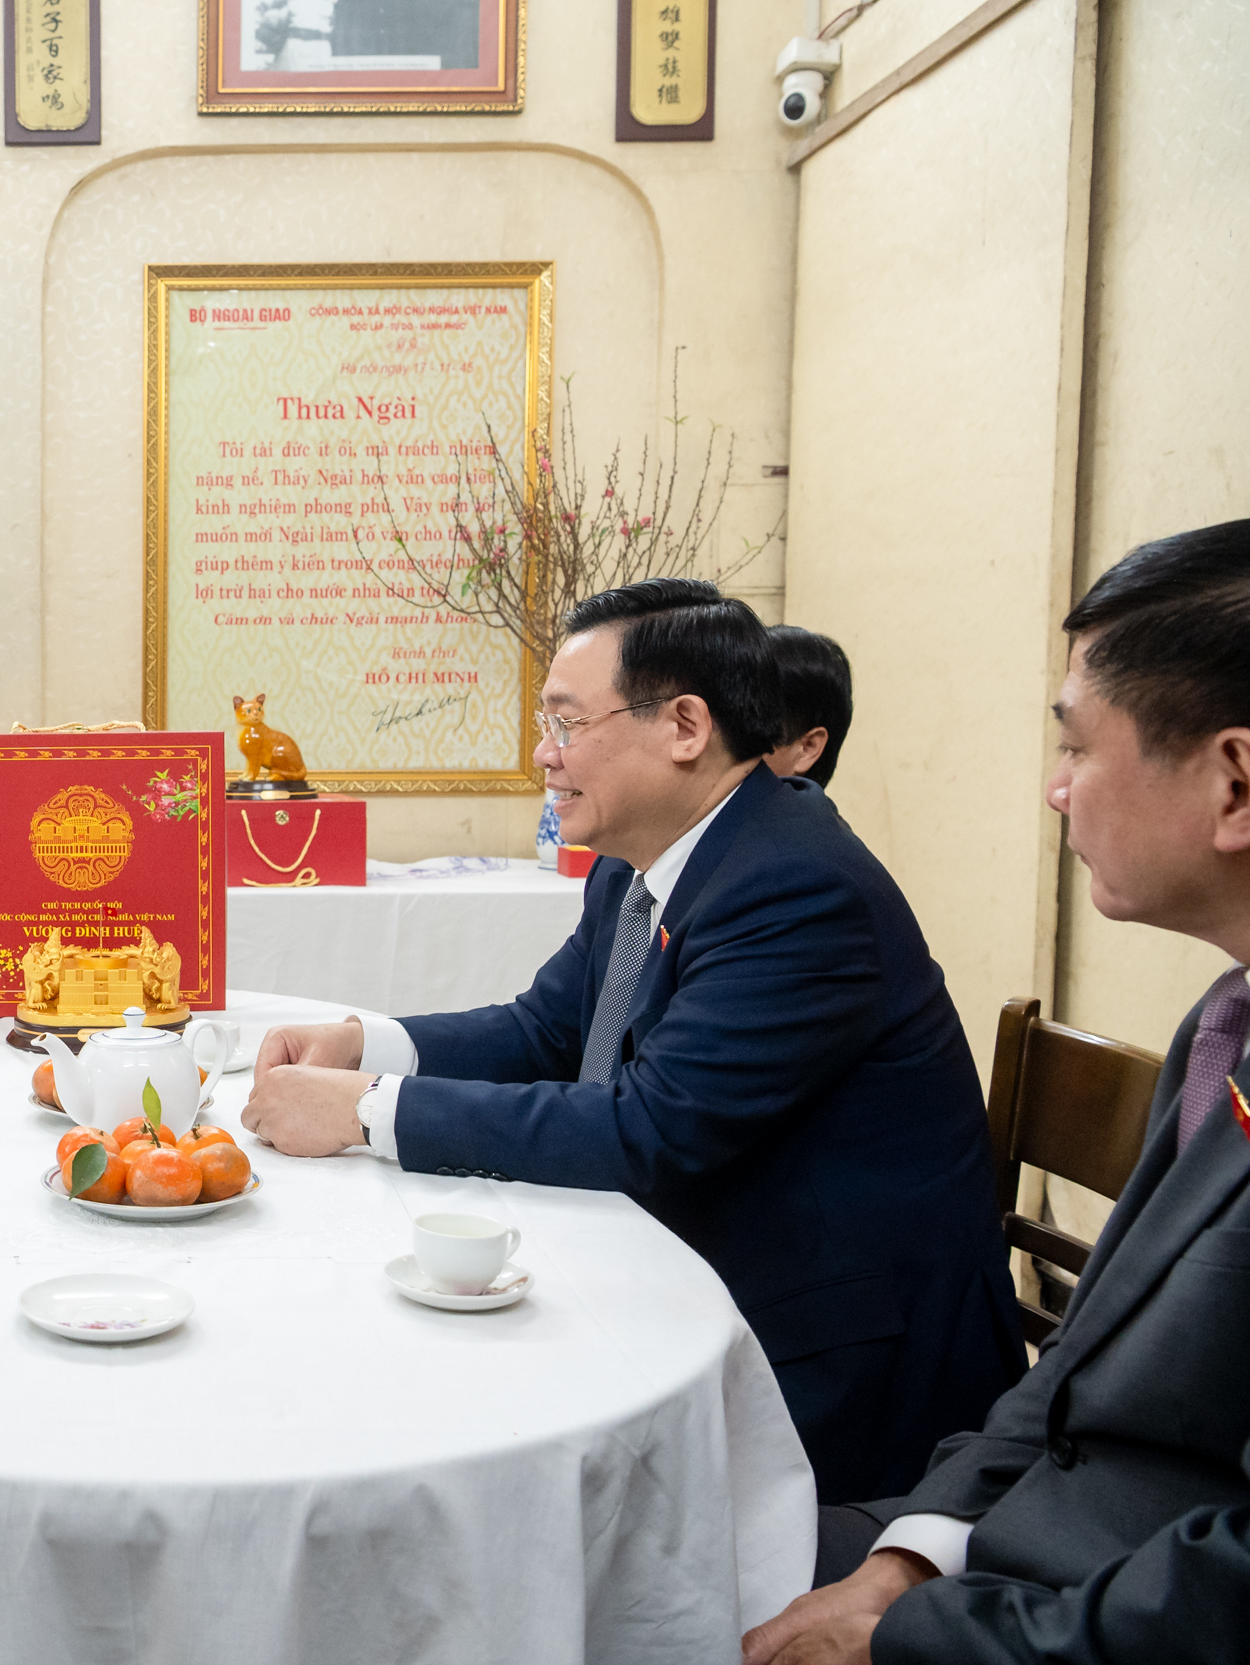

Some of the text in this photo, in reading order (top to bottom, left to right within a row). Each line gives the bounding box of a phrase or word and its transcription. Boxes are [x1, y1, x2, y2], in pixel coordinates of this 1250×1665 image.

[189, 305, 291, 326] BỘ NGOẠI GIAO
[485, 304, 508, 316] NAM
[414, 362, 427, 373] 17
[277, 395, 417, 426] Thưa Ngài
[219, 438, 496, 460] Tôi tài đức ít ỏi, mà trách nhiệm
[195, 471, 234, 491] nặng
[241, 466, 264, 487] nề.
[271, 467, 310, 490] Thấy
[317, 469, 353, 490] Ngài
[361, 469, 389, 490] học
[396, 466, 425, 485] vấn
[432, 472, 459, 486] cao
[195, 498, 231, 515] kinh
[238, 498, 297, 519] nghiệm
[304, 498, 353, 518] phong
[402, 497, 432, 518] Vậy
[440, 497, 468, 513] nên
[194, 524, 238, 543] muốn
[244, 526, 273, 543] mời
[279, 526, 314, 547] Ngài
[320, 526, 349, 542] làm
[354, 523, 377, 542] Cố
[414, 525, 442, 541] cho
[195, 555, 230, 575] giúp
[234, 555, 273, 571] thêm
[278, 554, 288, 574] ý
[291, 553, 326, 571] kiến
[331, 558, 374, 574] trong
[378, 554, 416, 574] công
[420, 554, 452, 573] việc
[195, 583, 214, 604] lợi
[219, 584, 244, 599] trừ
[248, 583, 272, 604] hại
[276, 582, 304, 599] cho
[309, 582, 347, 599] nước
[352, 582, 381, 598] nhà
[386, 582, 415, 598] dân
[253, 614, 273, 626] ơn
[278, 612, 295, 625] và
[300, 612, 338, 626] chúc
[343, 612, 379, 627] Ngài
[384, 611, 429, 627] mạnh
[392, 646, 457, 660] Kính thư
[365, 667, 478, 685] HỒ CHÍ MINH
[41, 900, 60, 910] CHỦ
[61, 902, 81, 911] TỊCH
[15, 912, 38, 923] CỘNG
[39, 912, 58, 922] HÒA
[59, 912, 70, 921] XÃ
[72, 912, 87, 923] HỘI
[135, 911, 155, 923] VIỆT
[156, 913, 175, 922] NAM
[23, 923, 143, 940] VƯƠG ĐÌNH HUỆ
